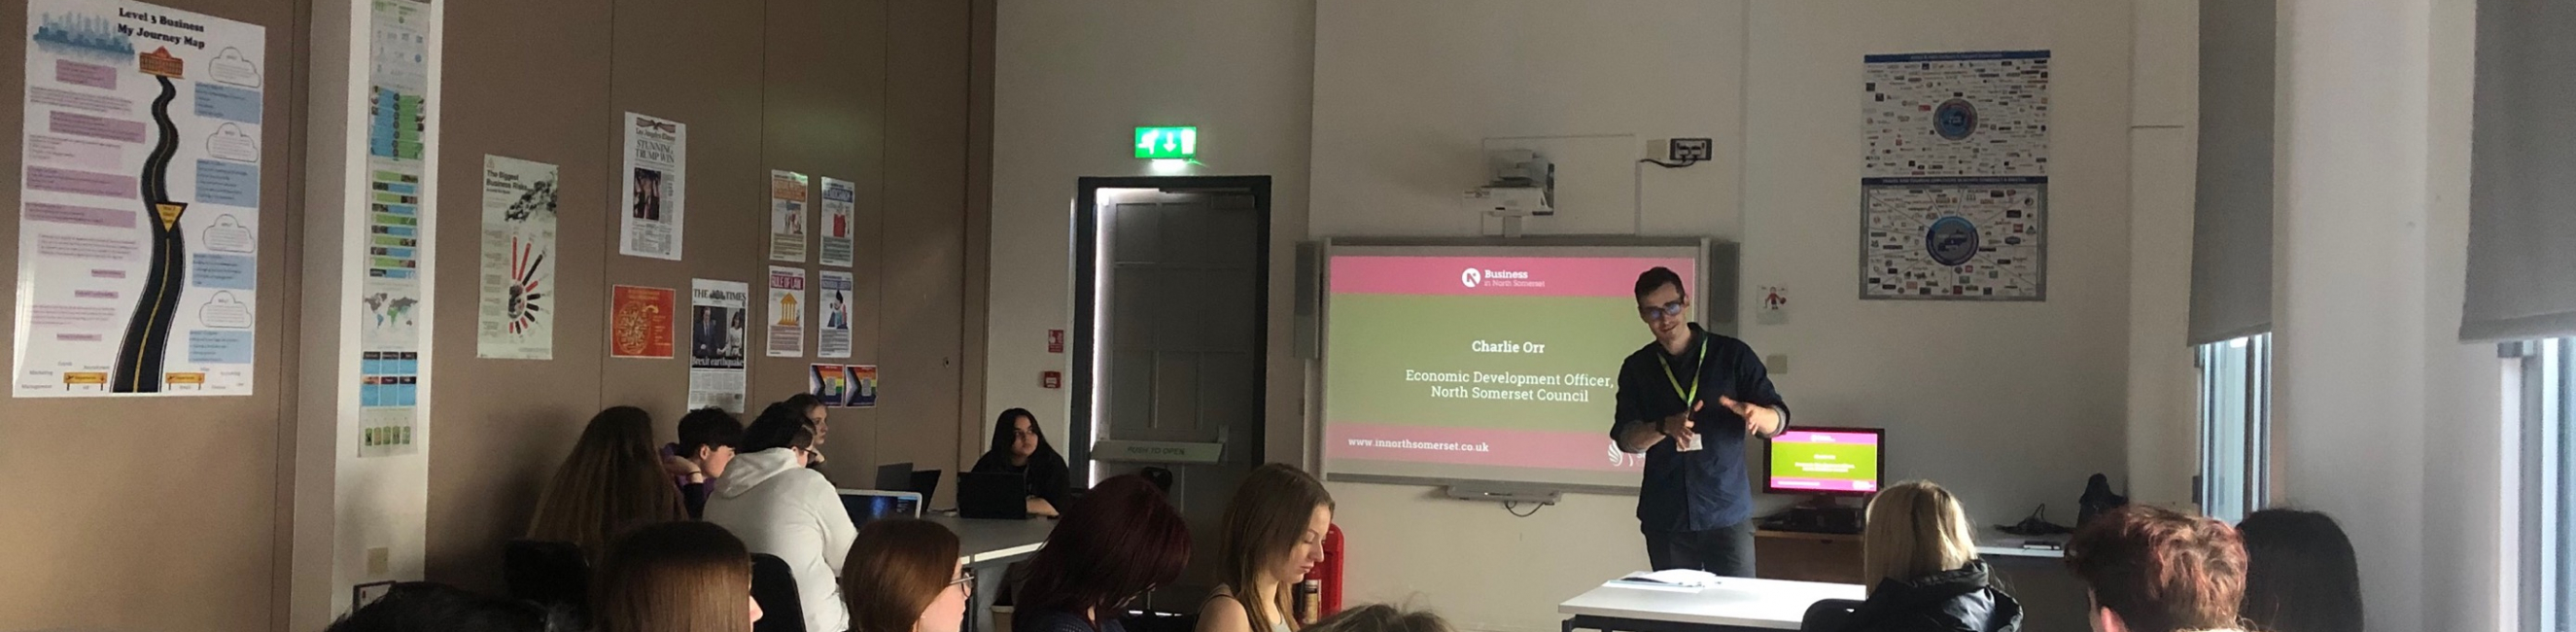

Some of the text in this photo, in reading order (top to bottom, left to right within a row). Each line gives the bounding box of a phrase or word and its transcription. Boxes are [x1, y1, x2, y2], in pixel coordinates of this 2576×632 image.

[119, 7, 148, 21] Level
[159, 16, 204, 32] Business
[118, 23, 205, 50] My Journey Map
[1484, 269, 1528, 279] Business
[693, 289, 747, 300] THE TIMES
[1472, 339, 1545, 353] Charlie Orr
[711, 357, 744, 369] earthquake
[1406, 369, 1614, 389] Economic Development Officer,
[1431, 386, 1588, 403] North Somerset Council
[1128, 445, 1149, 454] PUSH
[1348, 438, 1489, 452] www.innorthsomerset.co.uk
